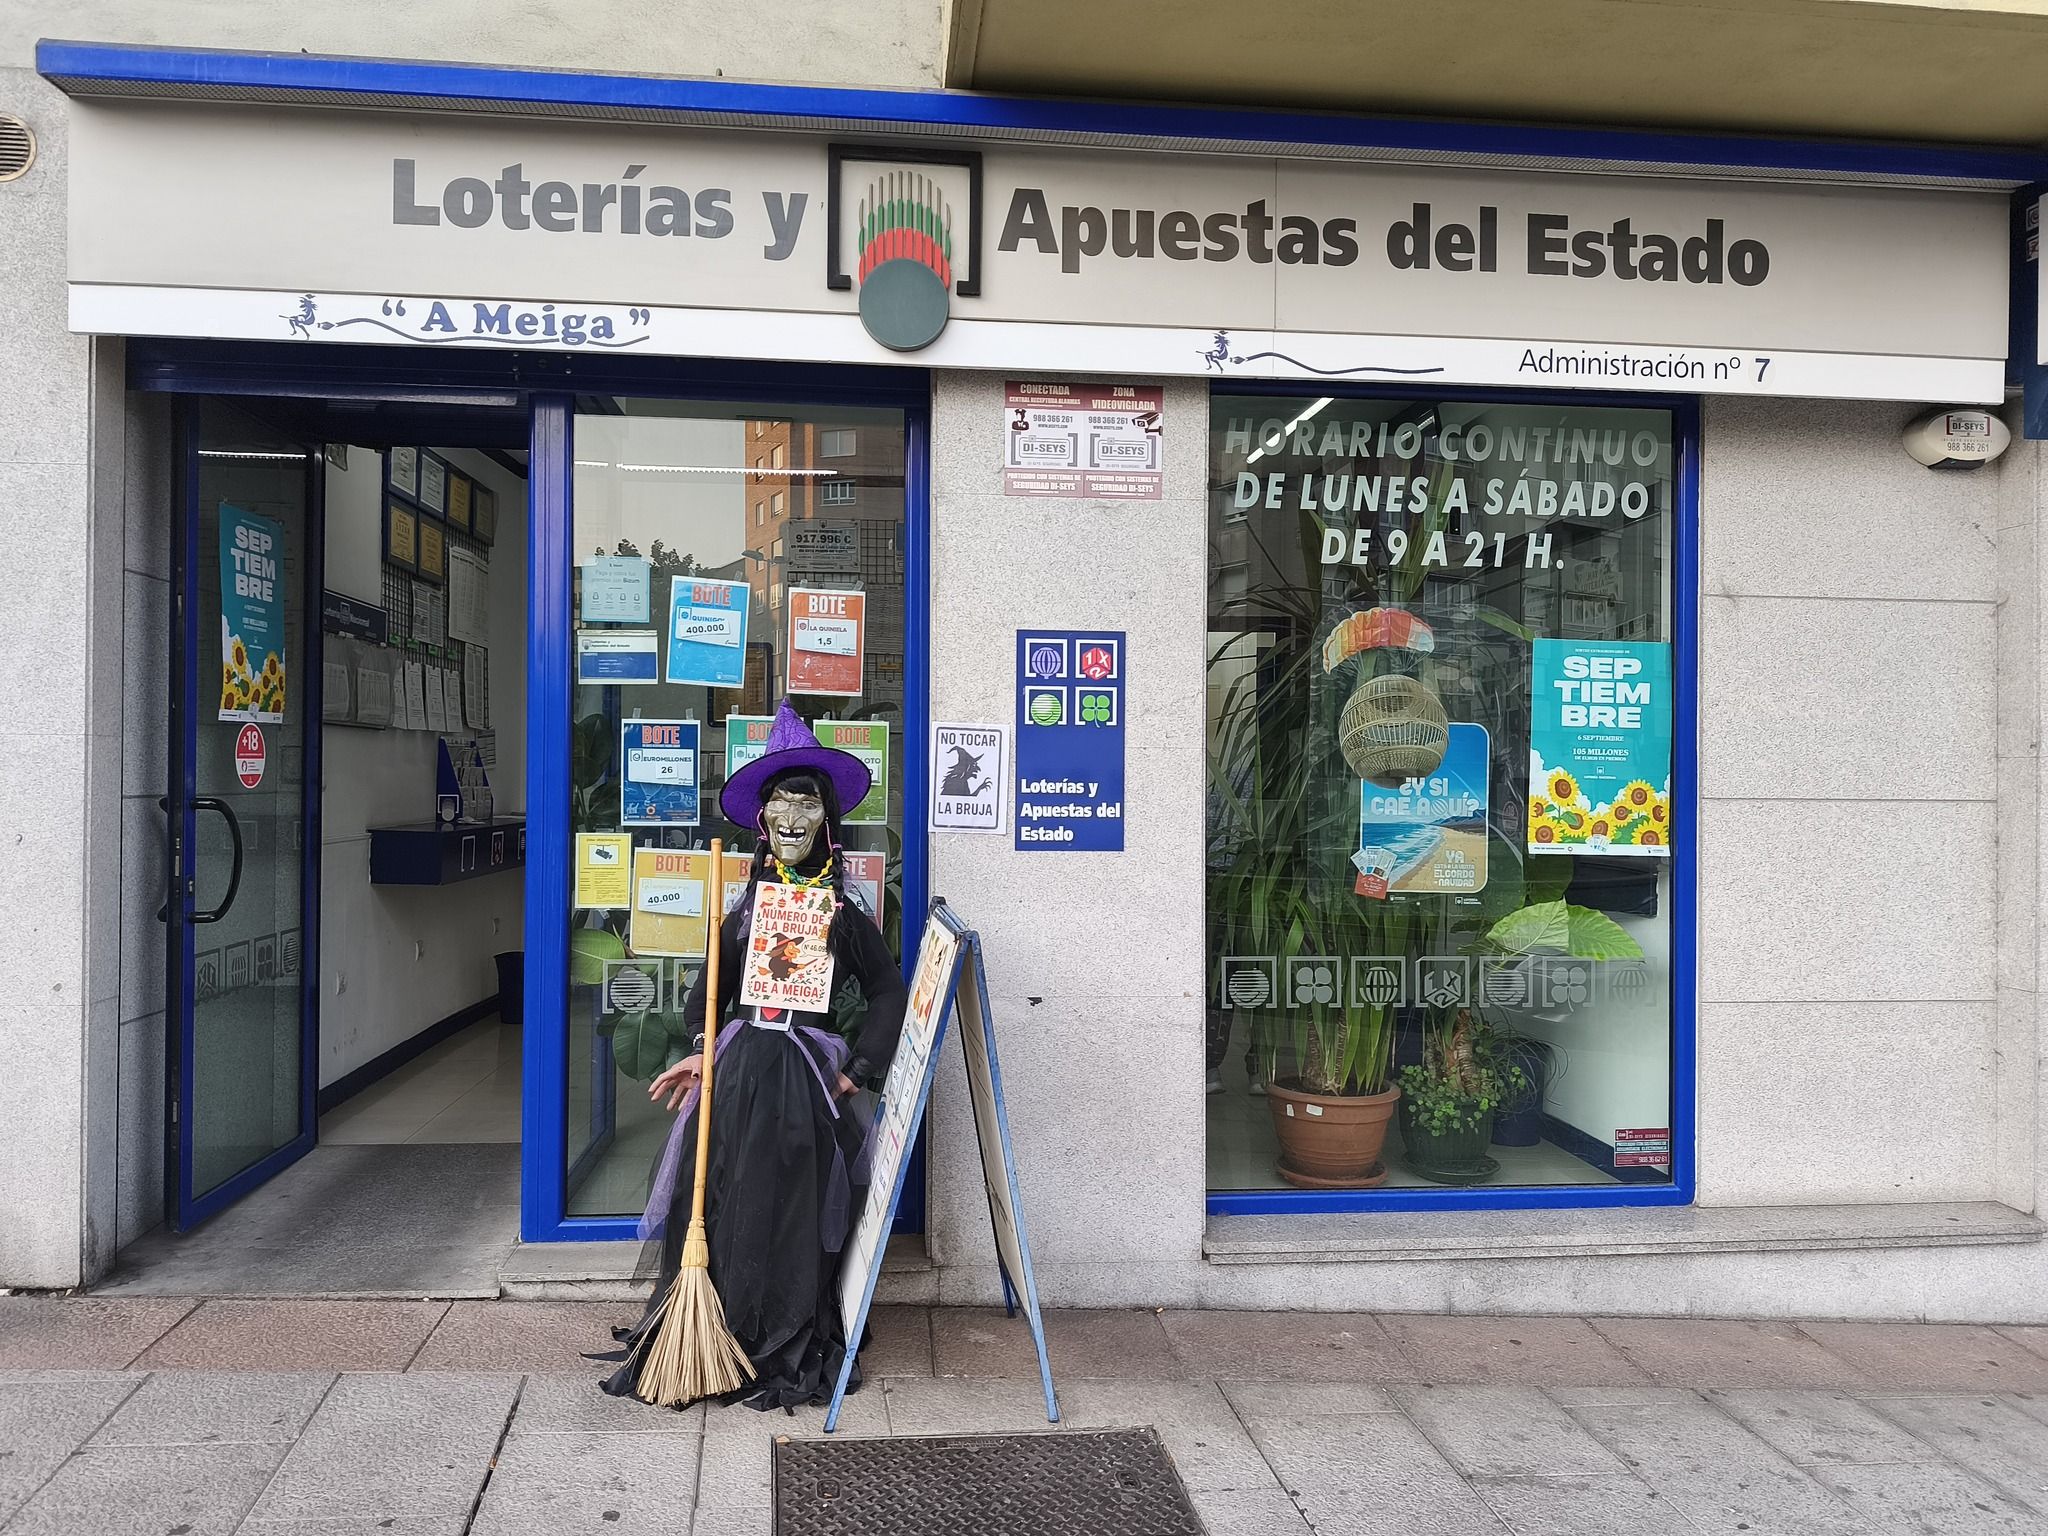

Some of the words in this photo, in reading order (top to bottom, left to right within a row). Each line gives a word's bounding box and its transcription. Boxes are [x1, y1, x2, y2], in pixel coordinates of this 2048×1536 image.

[392, 158, 735, 239] Loterías
[762, 190, 809, 261] y
[997, 187, 1359, 274] Apuestas
[1386, 202, 1498, 273] del
[1527, 212, 1771, 287] Estado
[1518, 347, 1706, 380] Administración
[1754, 358, 1771, 383] 7
[1020, 383, 1070, 396] CONECTADA
[1112, 386, 1135, 397] ZONA
[1091, 399, 1156, 411] VIDEOVIGILADA
[1033, 414, 1046, 422] 988
[1062, 415, 1073, 423] 261
[1088, 416, 1101, 424] 988
[1117, 417, 1128, 425] 261
[1952, 422, 1985, 431] DI-SEYS
[1023, 443, 1066, 454] DI-SEYS
[1224, 416, 1423, 461] HORARIO
[1438, 416, 1659, 467] CONTÍNUO
[1947, 442, 1960, 451] 988
[1962, 443, 1976, 452] 366
[1977, 443, 1989, 453] 261
[1101, 445, 1145, 456] DI-SEYS
[1012, 481, 1050, 490] SEGURIDAD
[1050, 482, 1076, 491] DI-SEYS
[1091, 483, 1128, 492] SEGURIDAD
[1129, 484, 1154, 493] DI-SEYS
[1233, 471, 1286, 510] DE
[1299, 472, 1429, 515] LUNES
[1441, 477, 1470, 515] A
[1482, 467, 1650, 520] SÁBADO
[234, 525, 272, 555] SEP
[795, 534, 841, 544] 917.996
[1320, 529, 1372, 566] DE
[1387, 529, 1408, 567] 9
[1420, 530, 1449, 568] A
[1462, 531, 1506, 569] 21
[1524, 532, 1565, 571] H.
[230, 548, 276, 581] TIEM
[234, 574, 273, 603] BRE
[692, 583, 732, 606] BOTE
[808, 594, 847, 615] BOTE
[686, 624, 725, 634] 400.000
[817, 637, 832, 646] 1,5
[1562, 655, 1643, 680] SEP
[1553, 680, 1651, 705] TIEM
[1561, 704, 1642, 729] BRE
[242, 730, 259, 751] +18
[641, 724, 681, 745] BOTE
[834, 725, 872, 746] BOTE
[940, 732, 956, 746] NO
[959, 733, 997, 747] TOCAR
[643, 755, 692, 763] EUROMILLONES
[1587, 748, 1629, 756] MILLONES
[661, 766, 673, 774] 26
[1020, 778, 1085, 794] Loterías
[1088, 781, 1099, 798] y
[1398, 776, 1426, 797] ¿Y
[1429, 777, 1449, 797] SI
[938, 801, 952, 815] LA
[956, 802, 993, 817] BRUJA
[1020, 802, 1093, 821] Apuestas
[1096, 802, 1121, 818] del
[1370, 796, 1411, 816] CAE
[1416, 791, 1480, 819] AQUÍ?
[1020, 826, 1074, 842] Estado
[655, 854, 692, 873] BOTE
[1445, 850, 1465, 864] YA
[1434, 869, 1445, 878] EL
[1445, 869, 1475, 879] GORDO
[1438, 878, 1475, 887] NAVIDAD
[647, 892, 681, 904] 40.000
[762, 907, 808, 924] NÚMERO
[811, 913, 825, 925] DE
[764, 920, 778, 932] LA
[782, 922, 819, 937] BRUJA
[753, 980, 768, 994] DE
[770, 982, 779, 995] A
[782, 983, 819, 999] MEIGA
